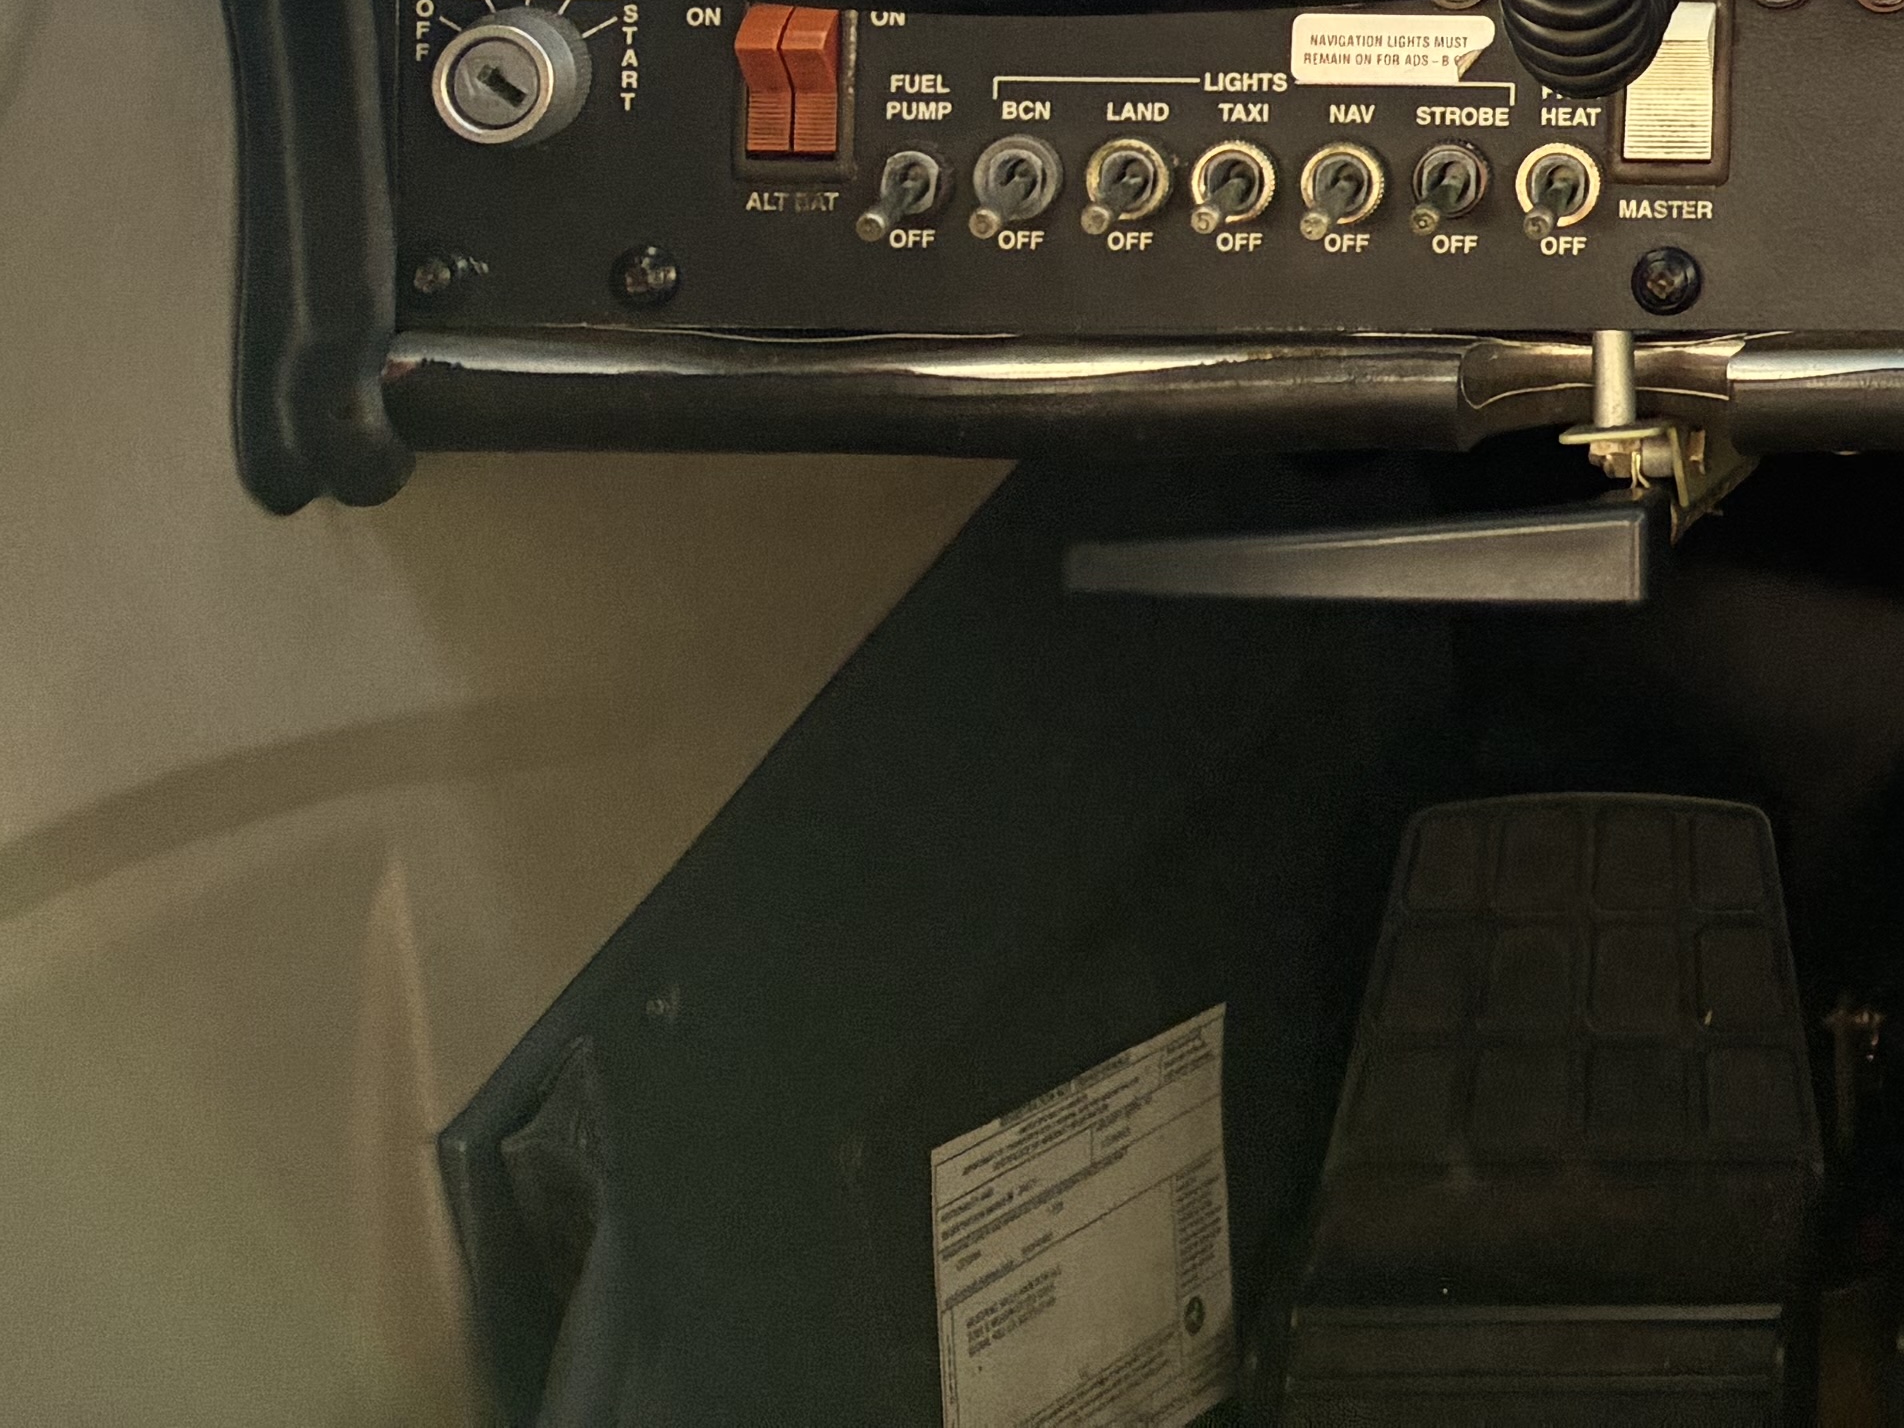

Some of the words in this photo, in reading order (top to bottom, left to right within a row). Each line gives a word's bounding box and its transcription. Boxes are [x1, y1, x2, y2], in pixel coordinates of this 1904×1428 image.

[889, 73, 951, 94] FUEL
[885, 100, 953, 121] PUMP
[1001, 100, 1051, 121] BCN
[1106, 101, 1170, 122] LAND
[1217, 102, 1270, 123] TAXI
[1329, 103, 1376, 124] NAV
[1415, 105, 1510, 127] STROBE
[1618, 199, 1713, 220] MASTER
